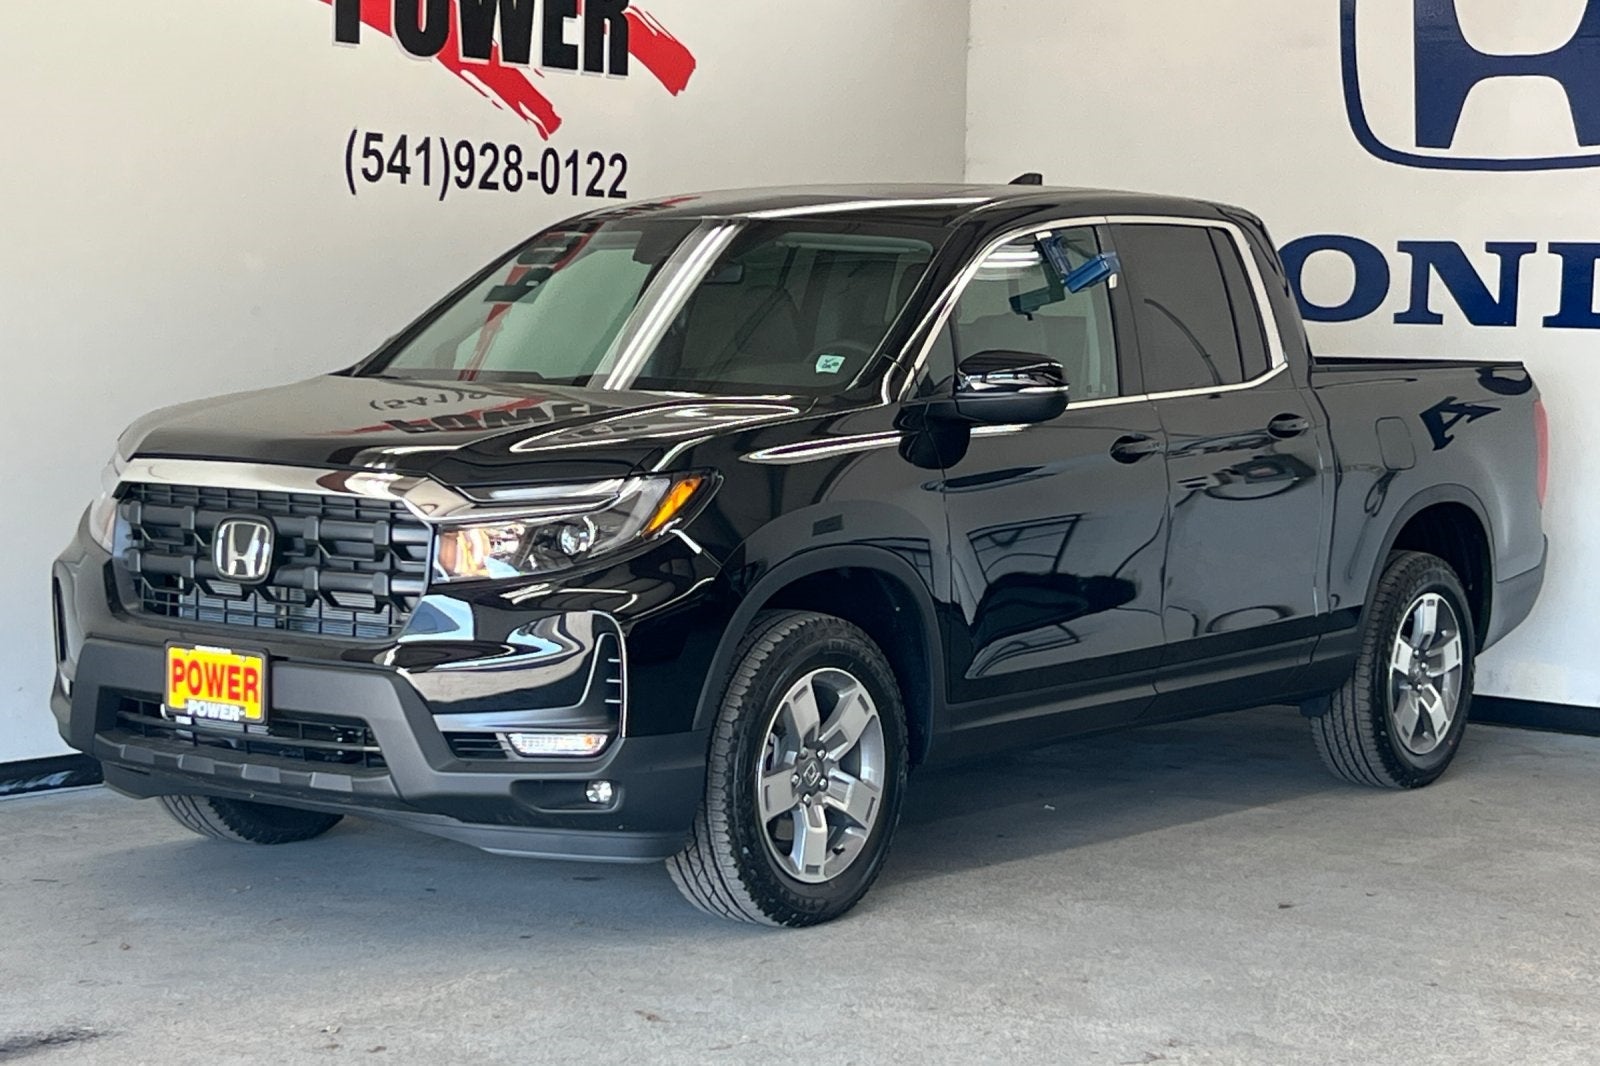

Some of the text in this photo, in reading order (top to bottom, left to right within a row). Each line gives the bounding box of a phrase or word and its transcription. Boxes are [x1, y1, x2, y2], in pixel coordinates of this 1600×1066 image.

[345, 128, 629, 200] (541)928-0122
[1277, 234, 1600, 328] ON
[172, 658, 259, 704] POWER
